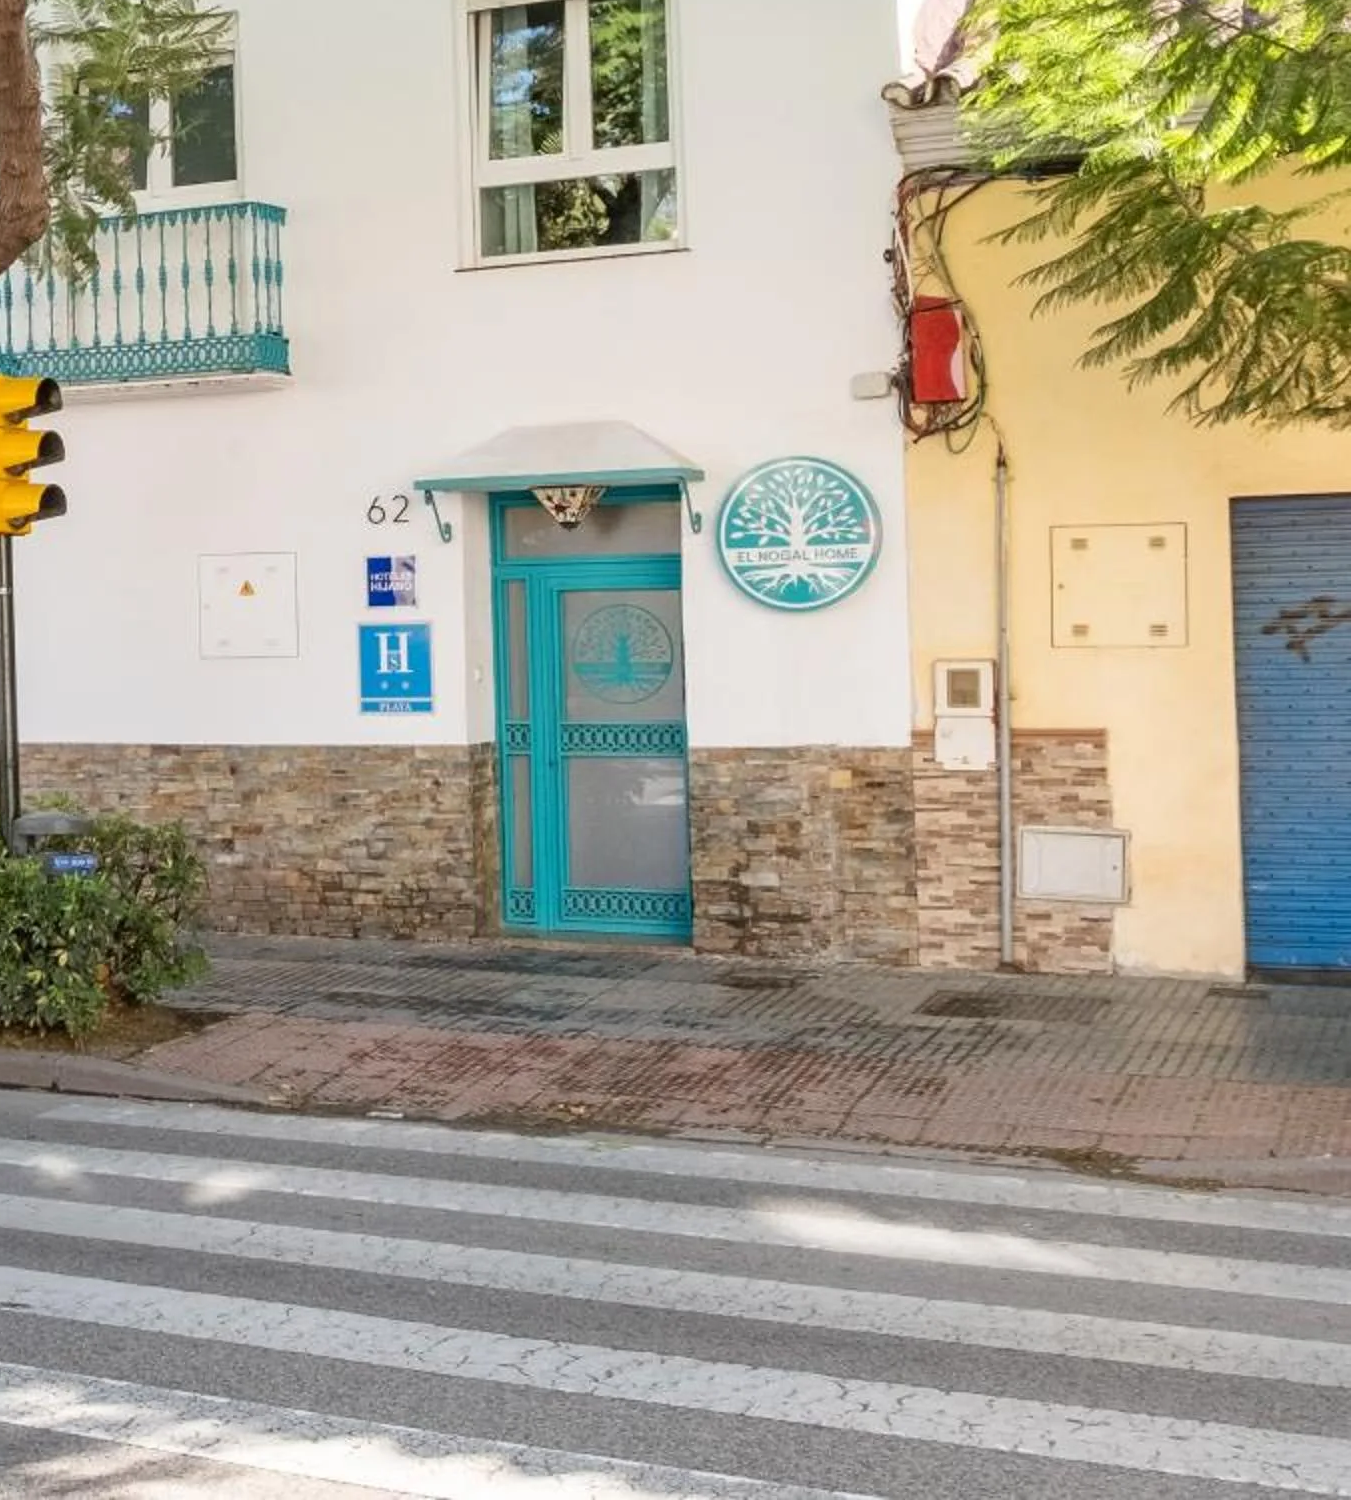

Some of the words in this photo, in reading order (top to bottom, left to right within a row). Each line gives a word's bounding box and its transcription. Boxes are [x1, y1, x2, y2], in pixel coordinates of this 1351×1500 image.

[367, 495, 410, 524] 62
[736, 551, 755, 561] EL
[758, 549, 810, 561] NOGAL
[814, 547, 858, 560] HOME
